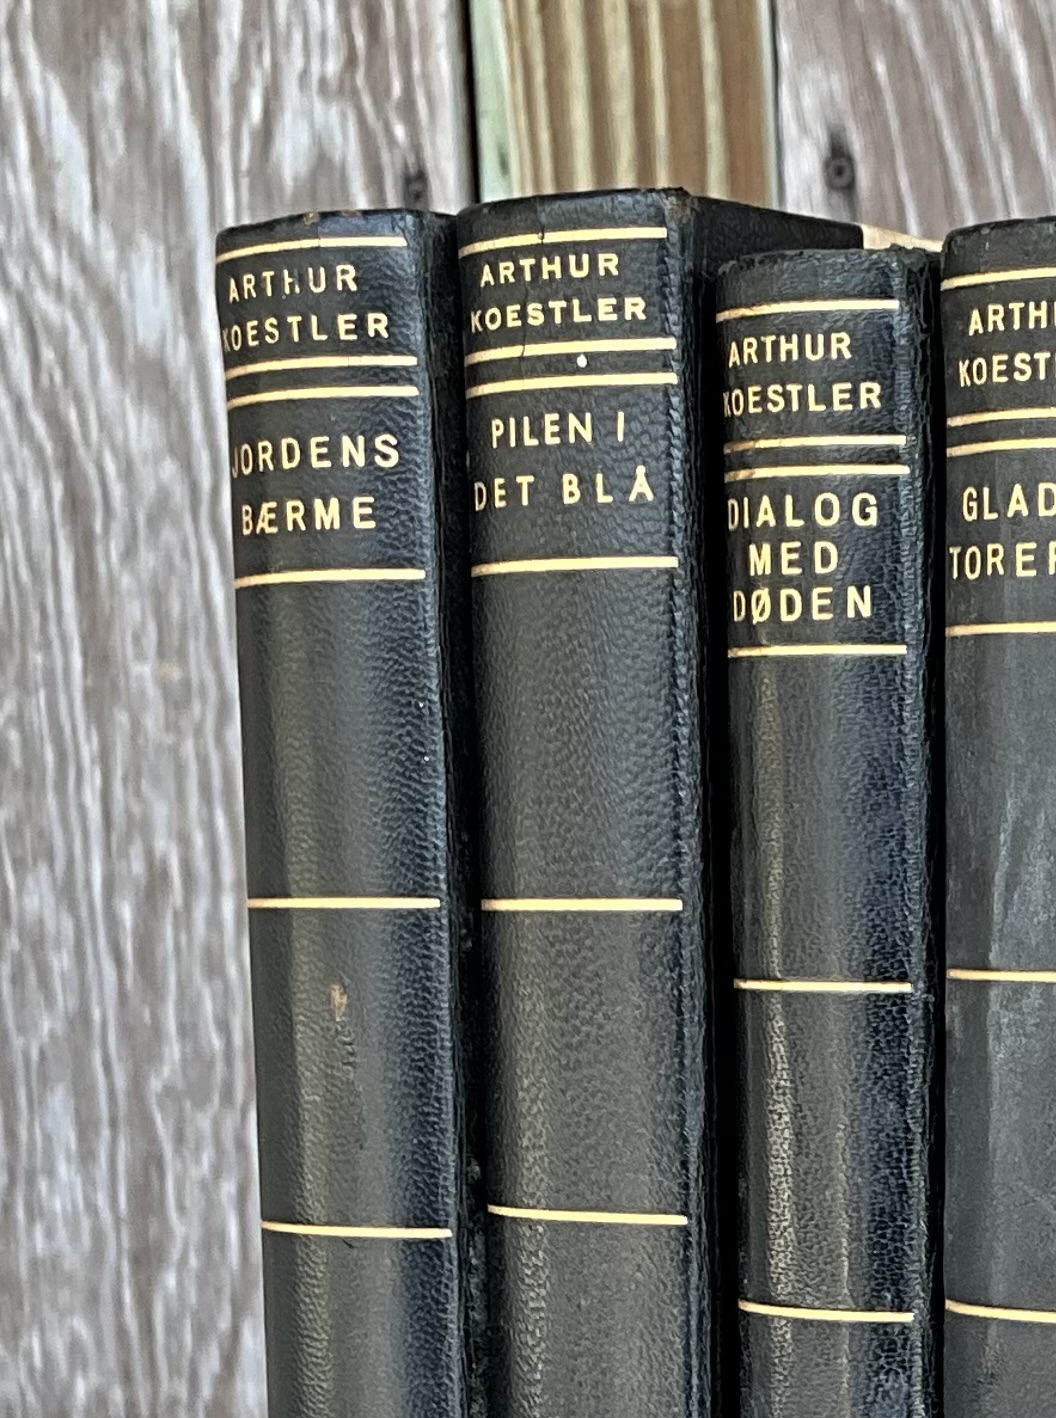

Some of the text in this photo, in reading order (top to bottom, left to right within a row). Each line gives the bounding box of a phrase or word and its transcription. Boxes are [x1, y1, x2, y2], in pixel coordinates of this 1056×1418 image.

[229, 264, 358, 303] ARTHUR
[480, 253, 619, 287] ARTHUR
[223, 312, 390, 352] KOESTLER
[470, 297, 646, 333] KOESTLER
[728, 331, 852, 368] ARTHUR
[723, 381, 882, 417] KOESTLER
[491, 411, 625, 448] PILEN I
[231, 434, 399, 478] JORDENS
[474, 465, 654, 511] DET BLÅ
[242, 496, 376, 535] BÆRME
[727, 492, 878, 530] DIALOG
[749, 541, 838, 576] MED
[733, 585, 872, 625] DØDEN
